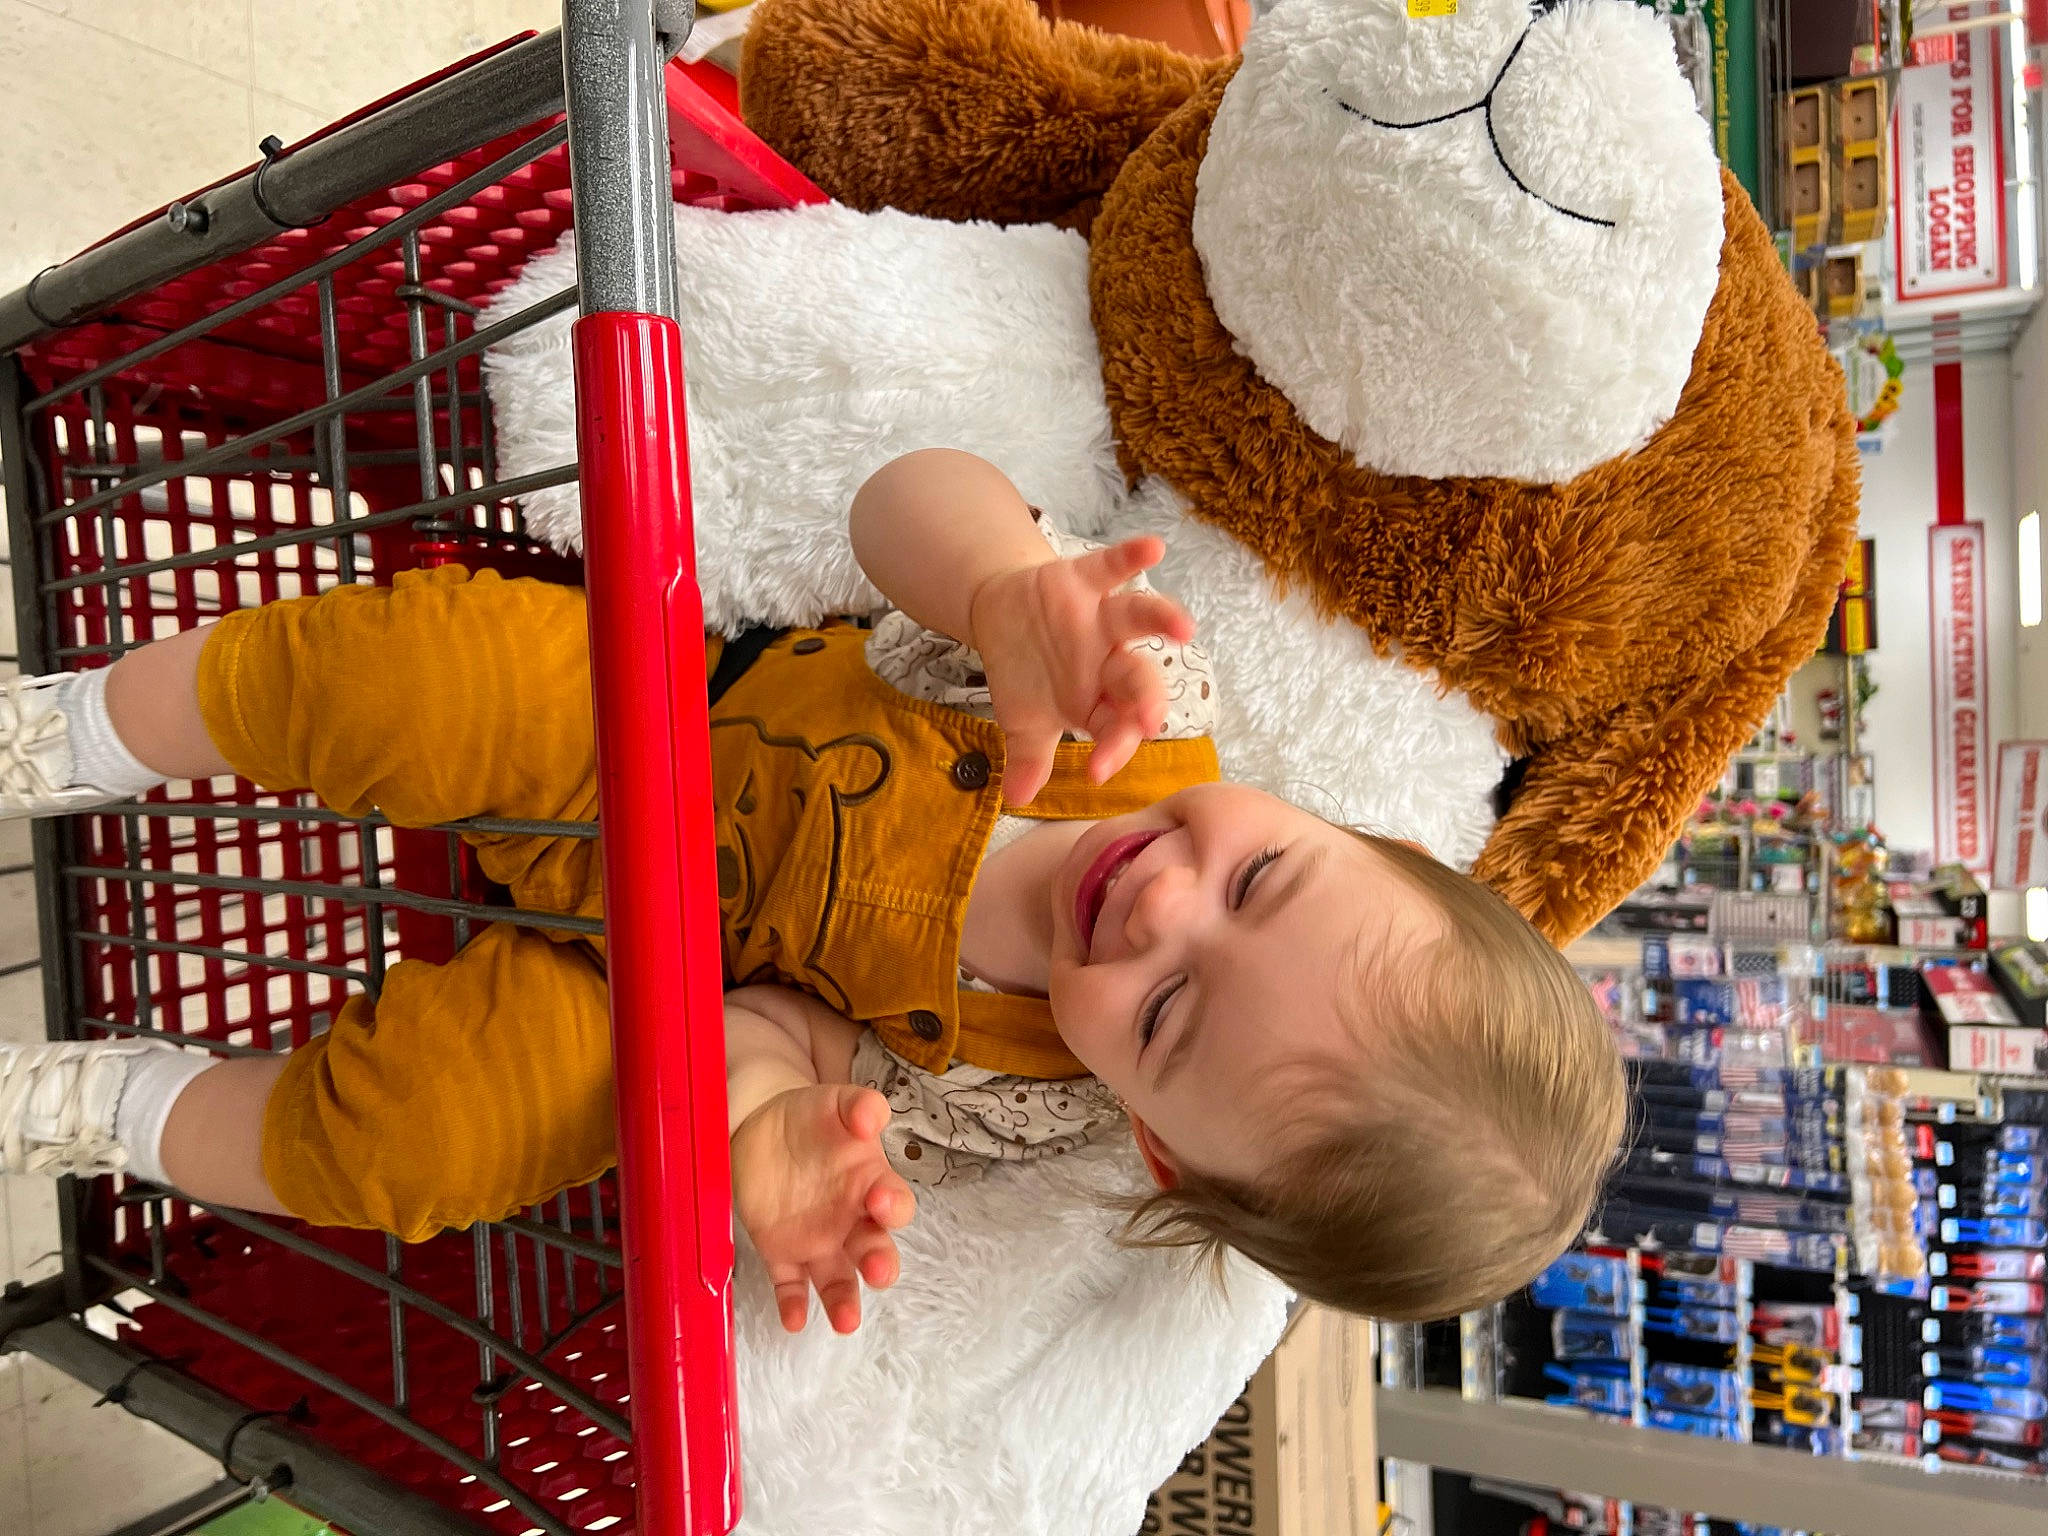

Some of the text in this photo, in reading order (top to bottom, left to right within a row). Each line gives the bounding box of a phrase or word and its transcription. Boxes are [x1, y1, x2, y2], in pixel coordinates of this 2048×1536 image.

[1951, 87, 1972, 137] FOR
[1929, 187, 1951, 272] LOGAN
[1953, 144, 1977, 269] SHOPPING
[1952, 538, 1977, 859] SATISFACTION GUARANTEED
